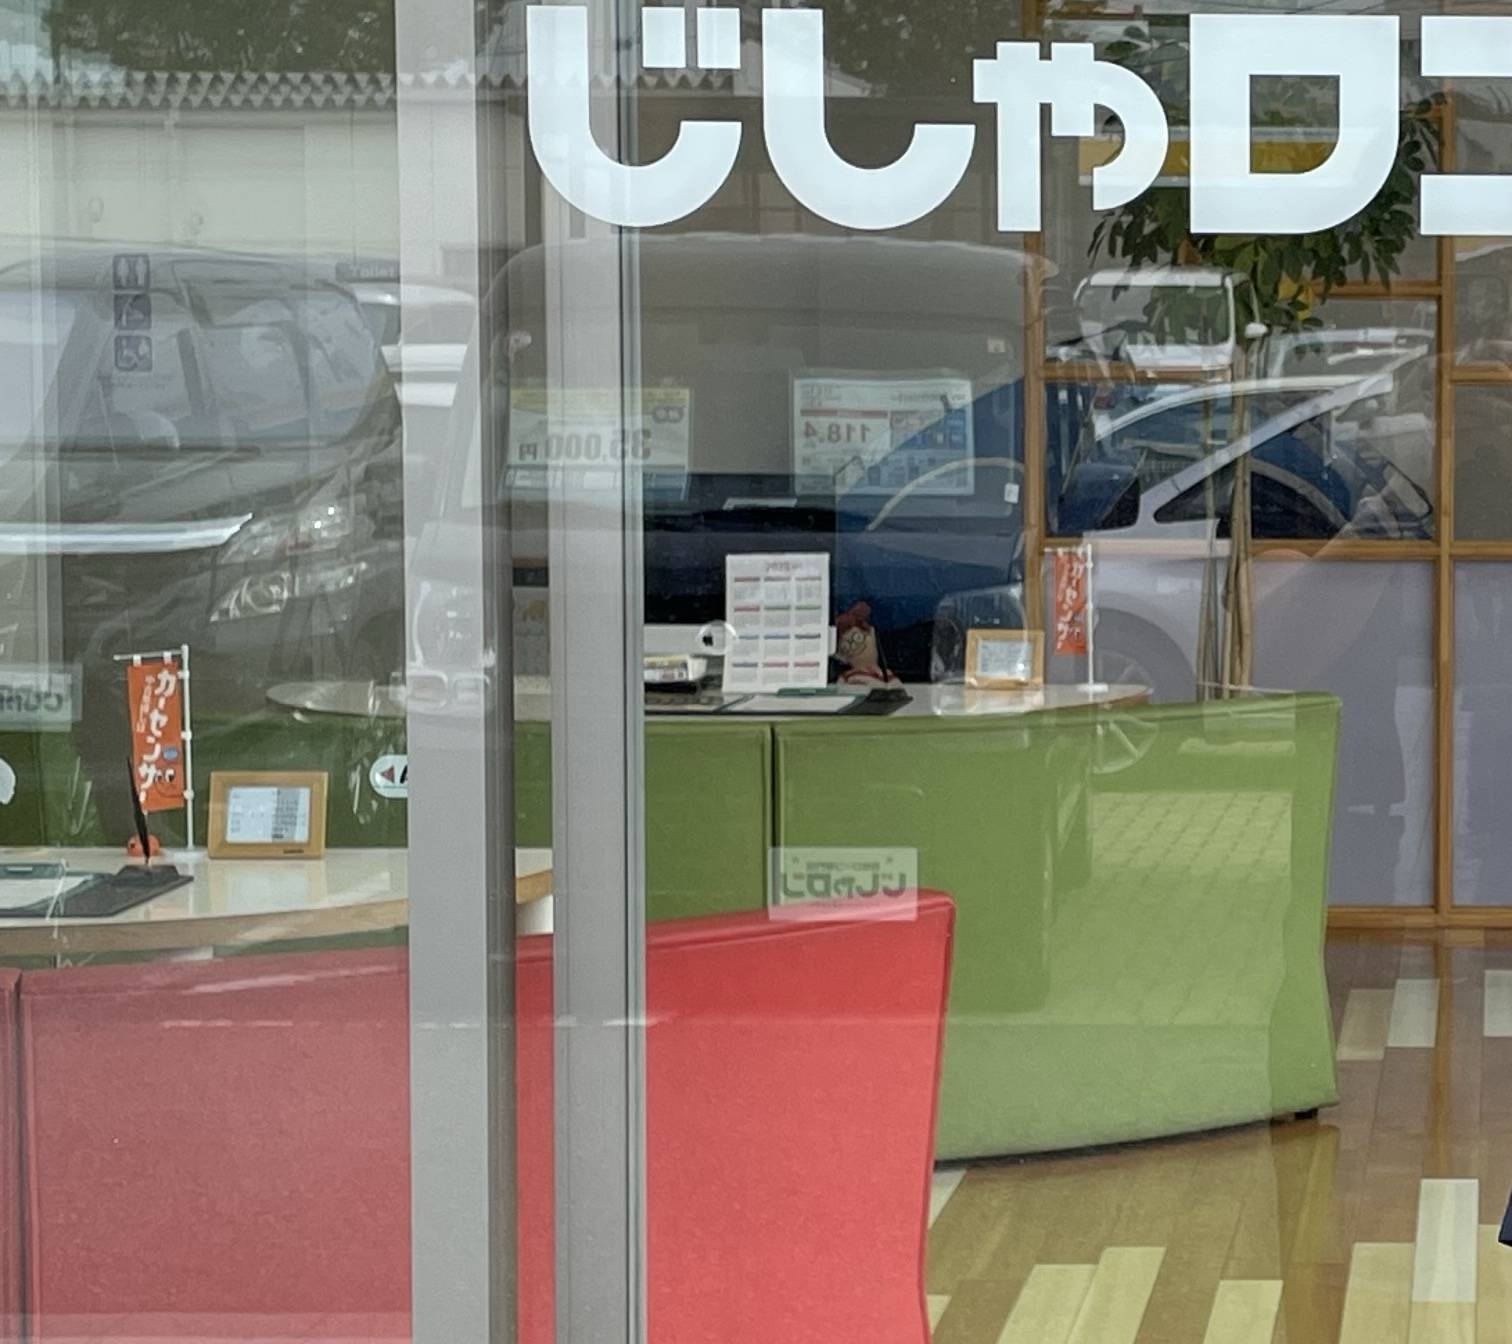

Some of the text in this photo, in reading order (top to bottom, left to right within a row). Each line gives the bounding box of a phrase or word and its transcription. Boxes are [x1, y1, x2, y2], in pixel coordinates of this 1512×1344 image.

[137, 668, 177, 804] カーセンサー
